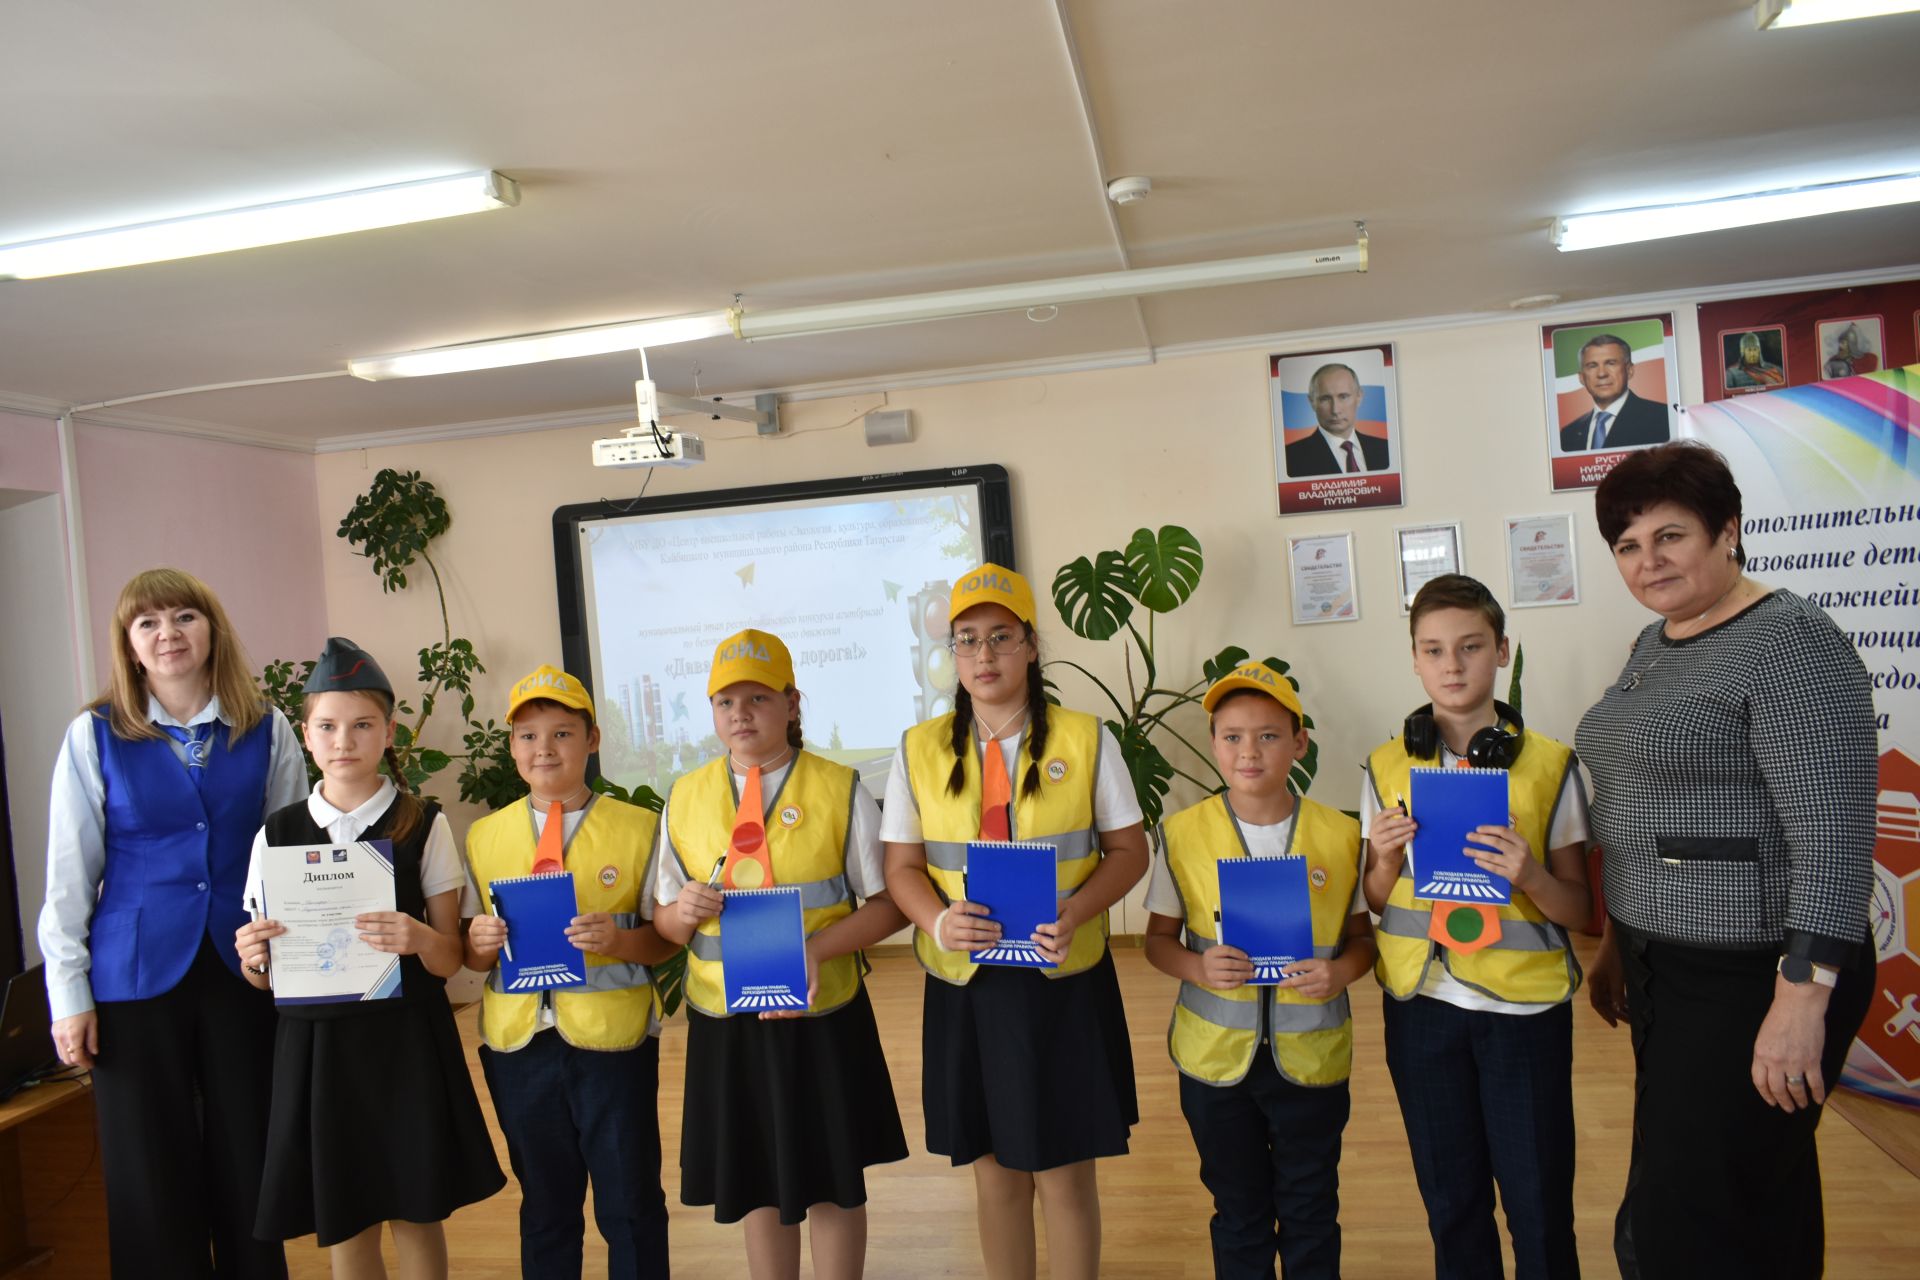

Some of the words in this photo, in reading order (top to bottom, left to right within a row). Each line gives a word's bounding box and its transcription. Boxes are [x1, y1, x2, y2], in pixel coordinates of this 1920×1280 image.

[1595, 454, 1628, 465] РУСТА
[1580, 463, 1617, 474] НУРГА
[1581, 472, 1608, 482] МИН
[1298, 485, 1381, 500] ВЛАДИМИРОВИЧ
[1311, 479, 1367, 491] ВЛАДИМИР
[1323, 496, 1357, 506] ПУТИН
[1742, 504, 1920, 536] ополнительн
[814, 536, 863, 551] Республики
[864, 532, 905, 548] Татарстан
[1746, 550, 1855, 573] азование
[961, 573, 1013, 595] ЮИД
[719, 640, 770, 664] ЮИД
[664, 657, 711, 680] «Дава
[518, 672, 568, 697] ЮИД
[303, 870, 355, 884] Диплом
